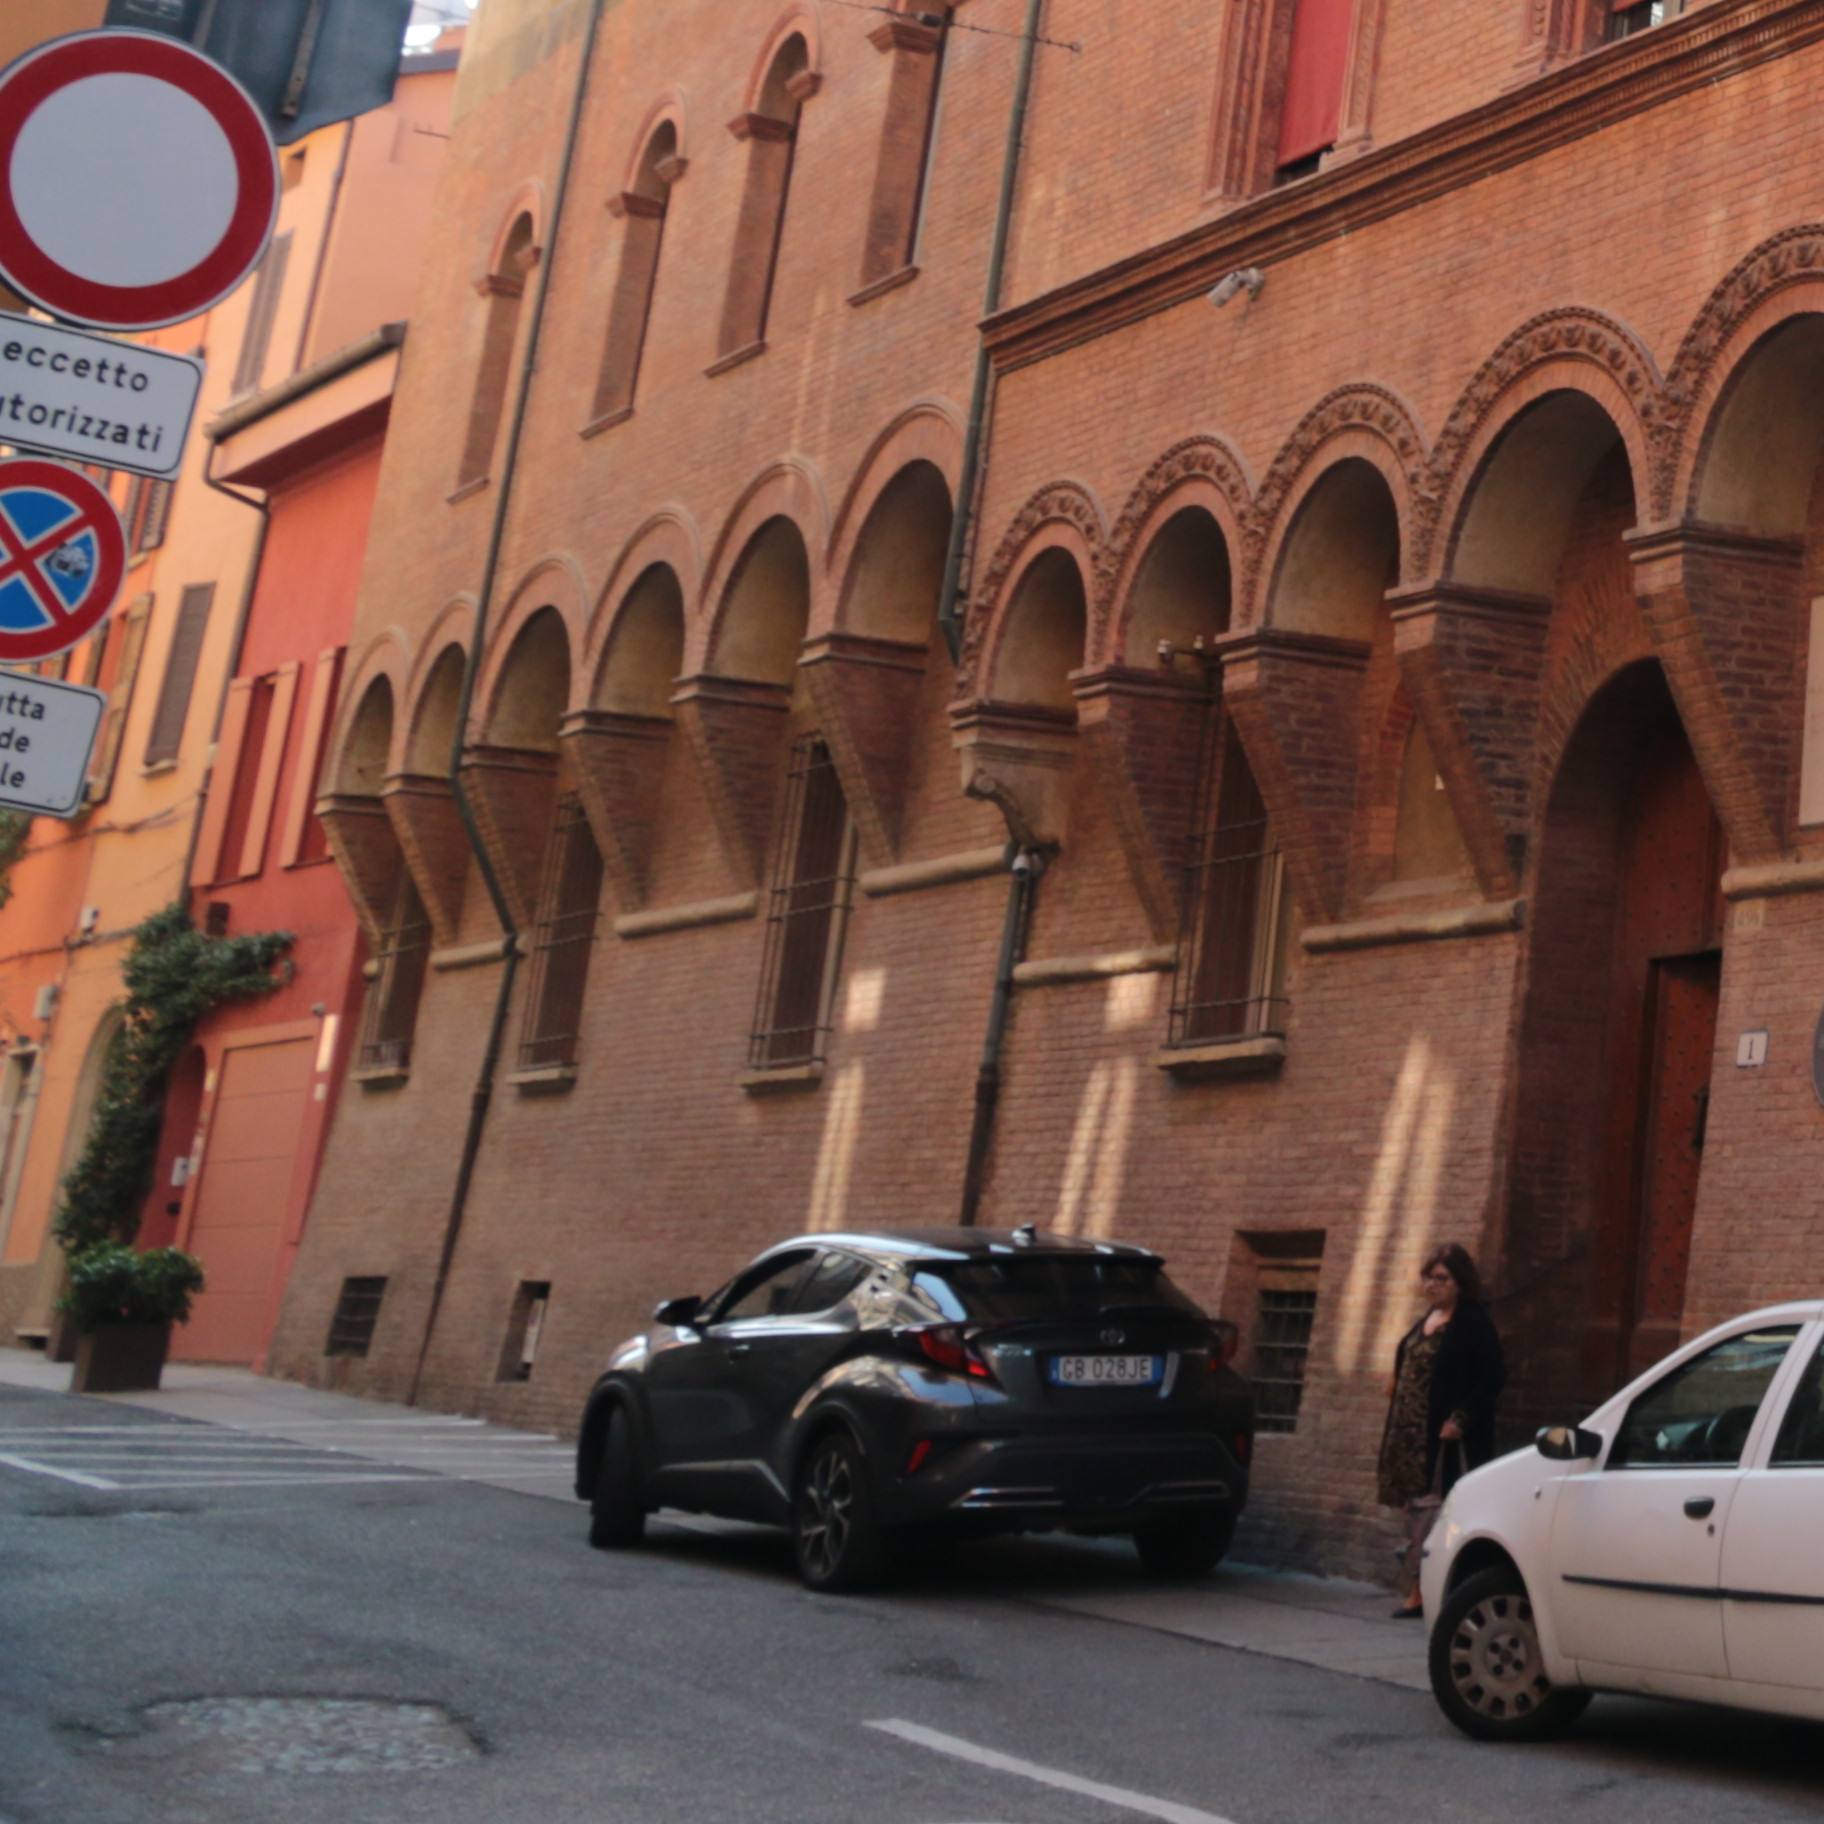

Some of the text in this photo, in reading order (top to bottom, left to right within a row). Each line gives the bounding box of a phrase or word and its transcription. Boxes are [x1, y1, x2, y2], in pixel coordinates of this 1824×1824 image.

[3, 341, 149, 392] eccetto
[0, 393, 163, 453] torizzati
[0, 691, 45, 721] tta
[1062, 1359, 1085, 1379] GB
